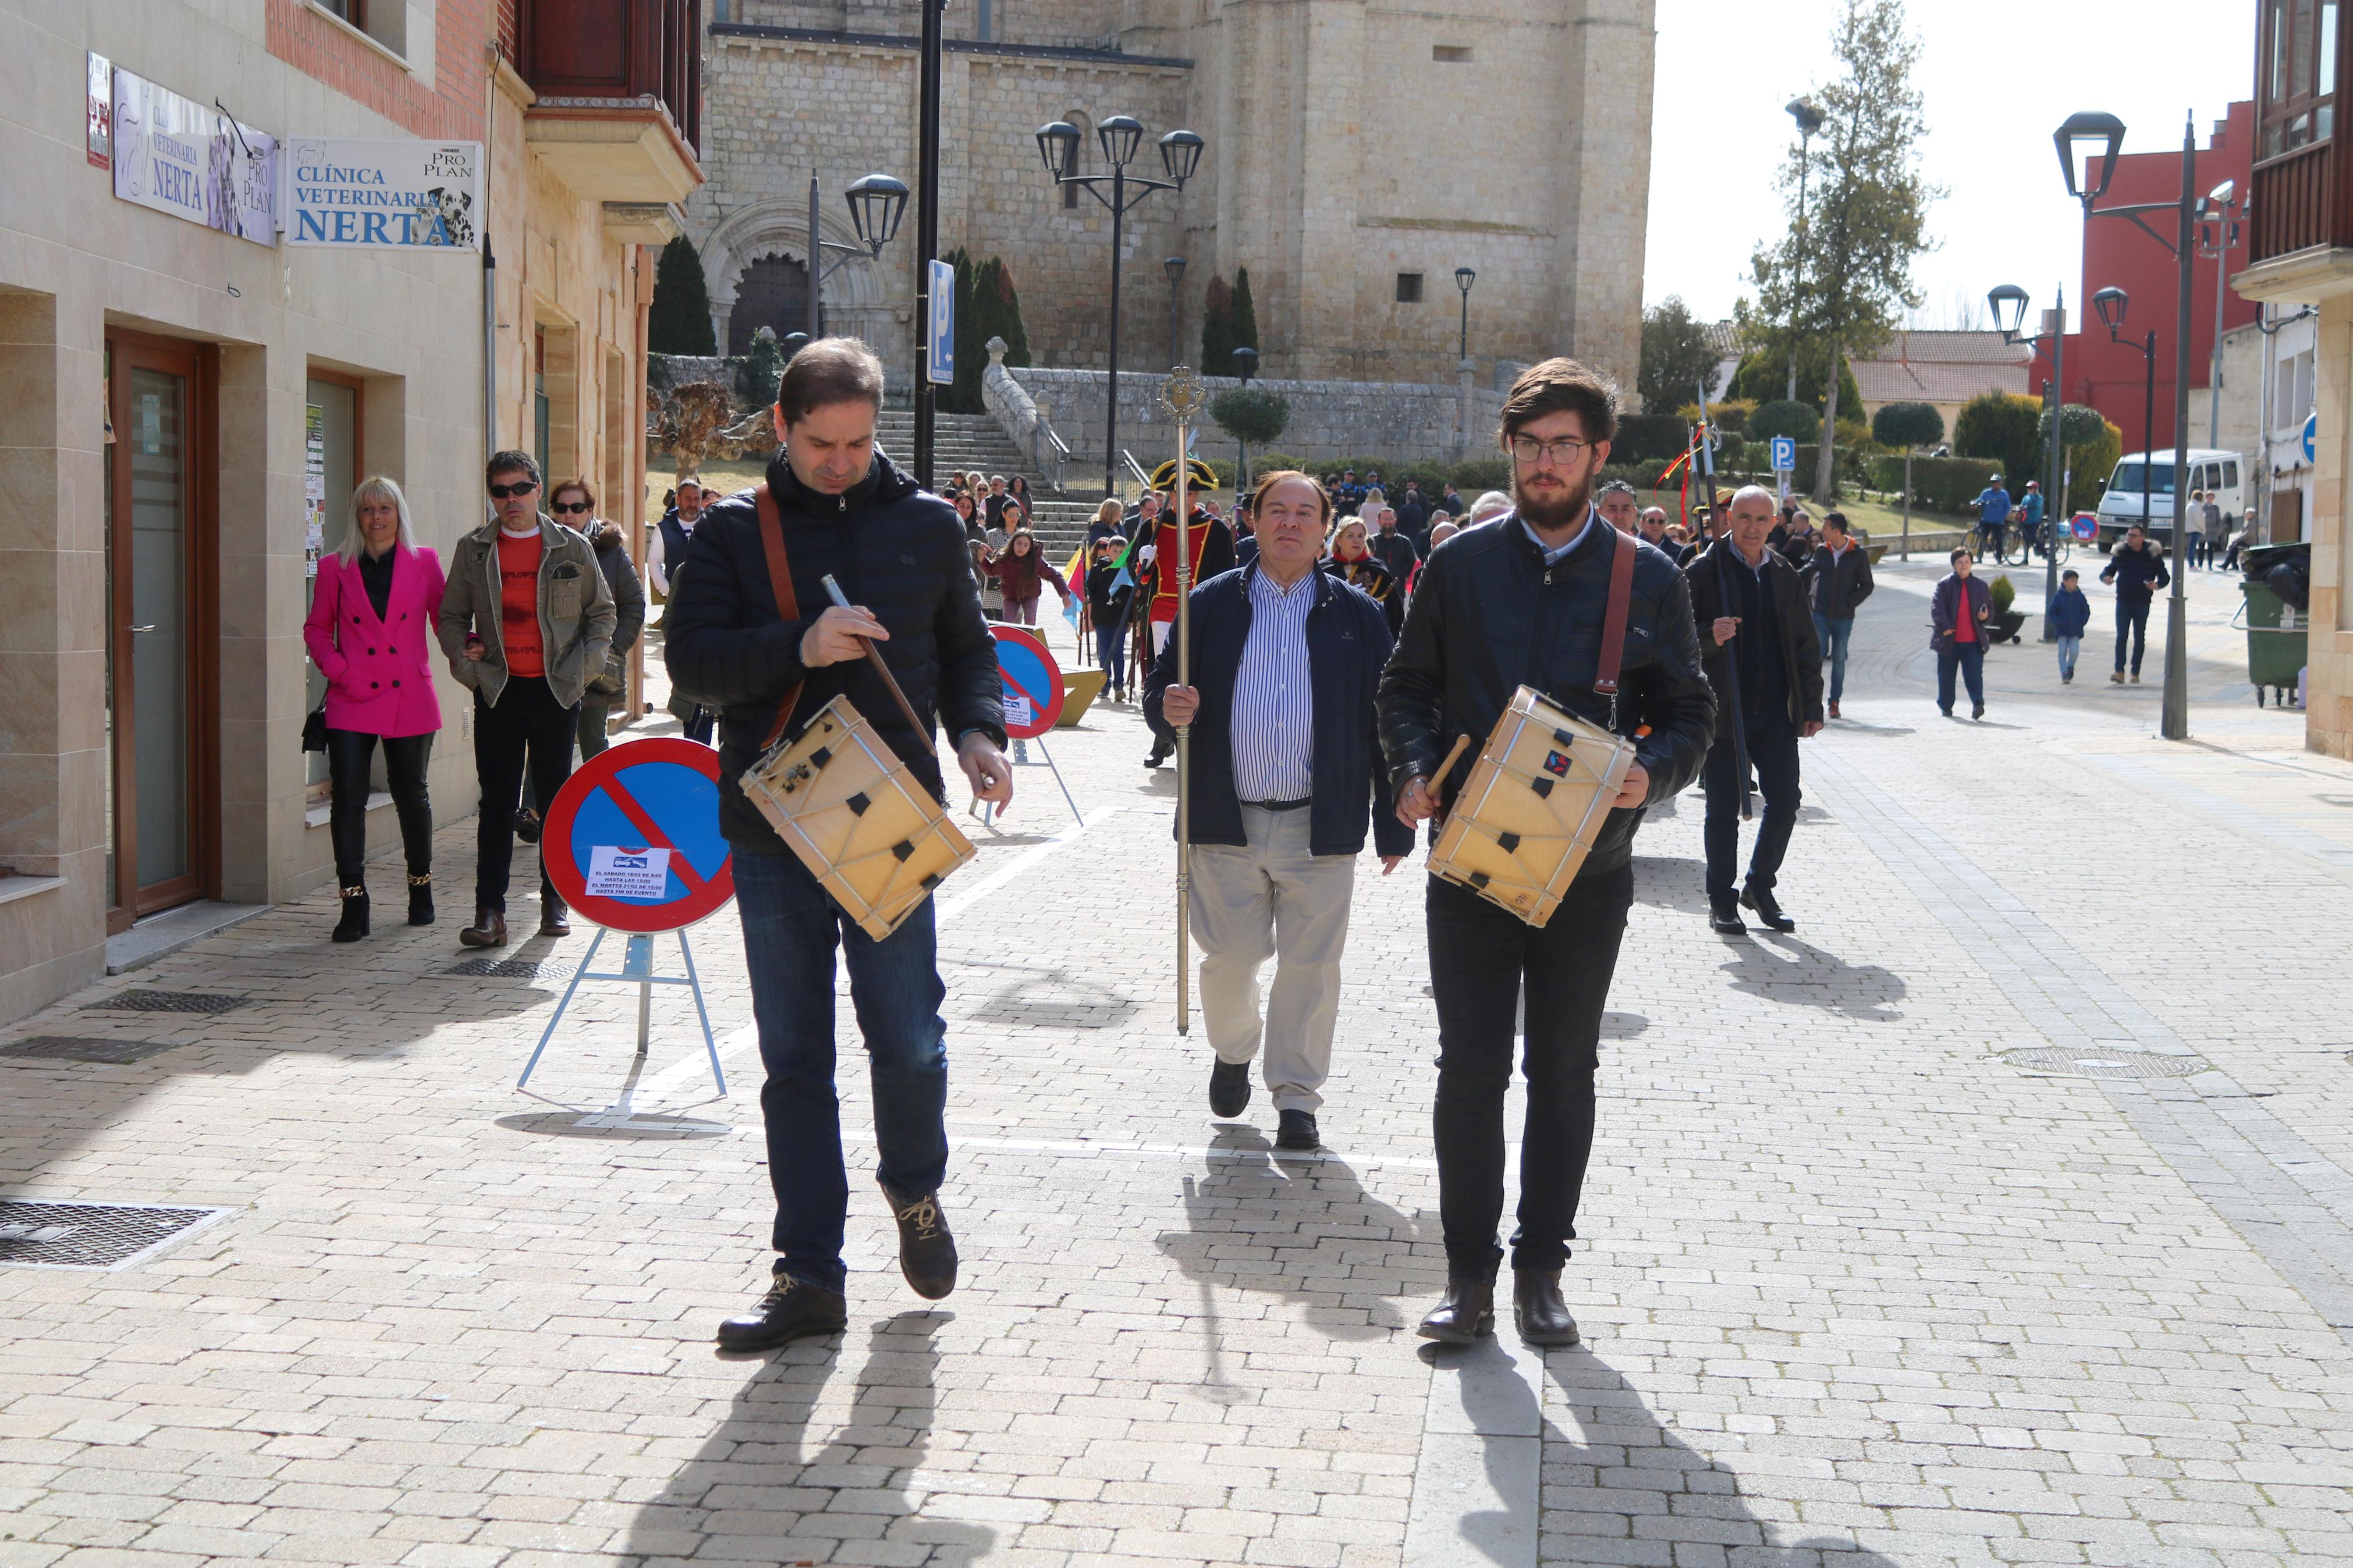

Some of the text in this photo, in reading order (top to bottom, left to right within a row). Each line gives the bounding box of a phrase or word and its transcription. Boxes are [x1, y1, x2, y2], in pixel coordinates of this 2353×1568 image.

[153, 132, 198, 166] VETERINARIA
[432, 152, 466, 166] PRO
[153, 158, 203, 211] NERTA
[249, 158, 268, 187] PRO
[296, 163, 386, 184] CLÍNICA
[424, 163, 472, 178] PLAN
[244, 180, 272, 215] PLAN
[294, 187, 440, 208] VETERINARIA
[294, 209, 456, 247] NERTA
[935, 277, 949, 367] P
[1776, 442, 1790, 466] P
